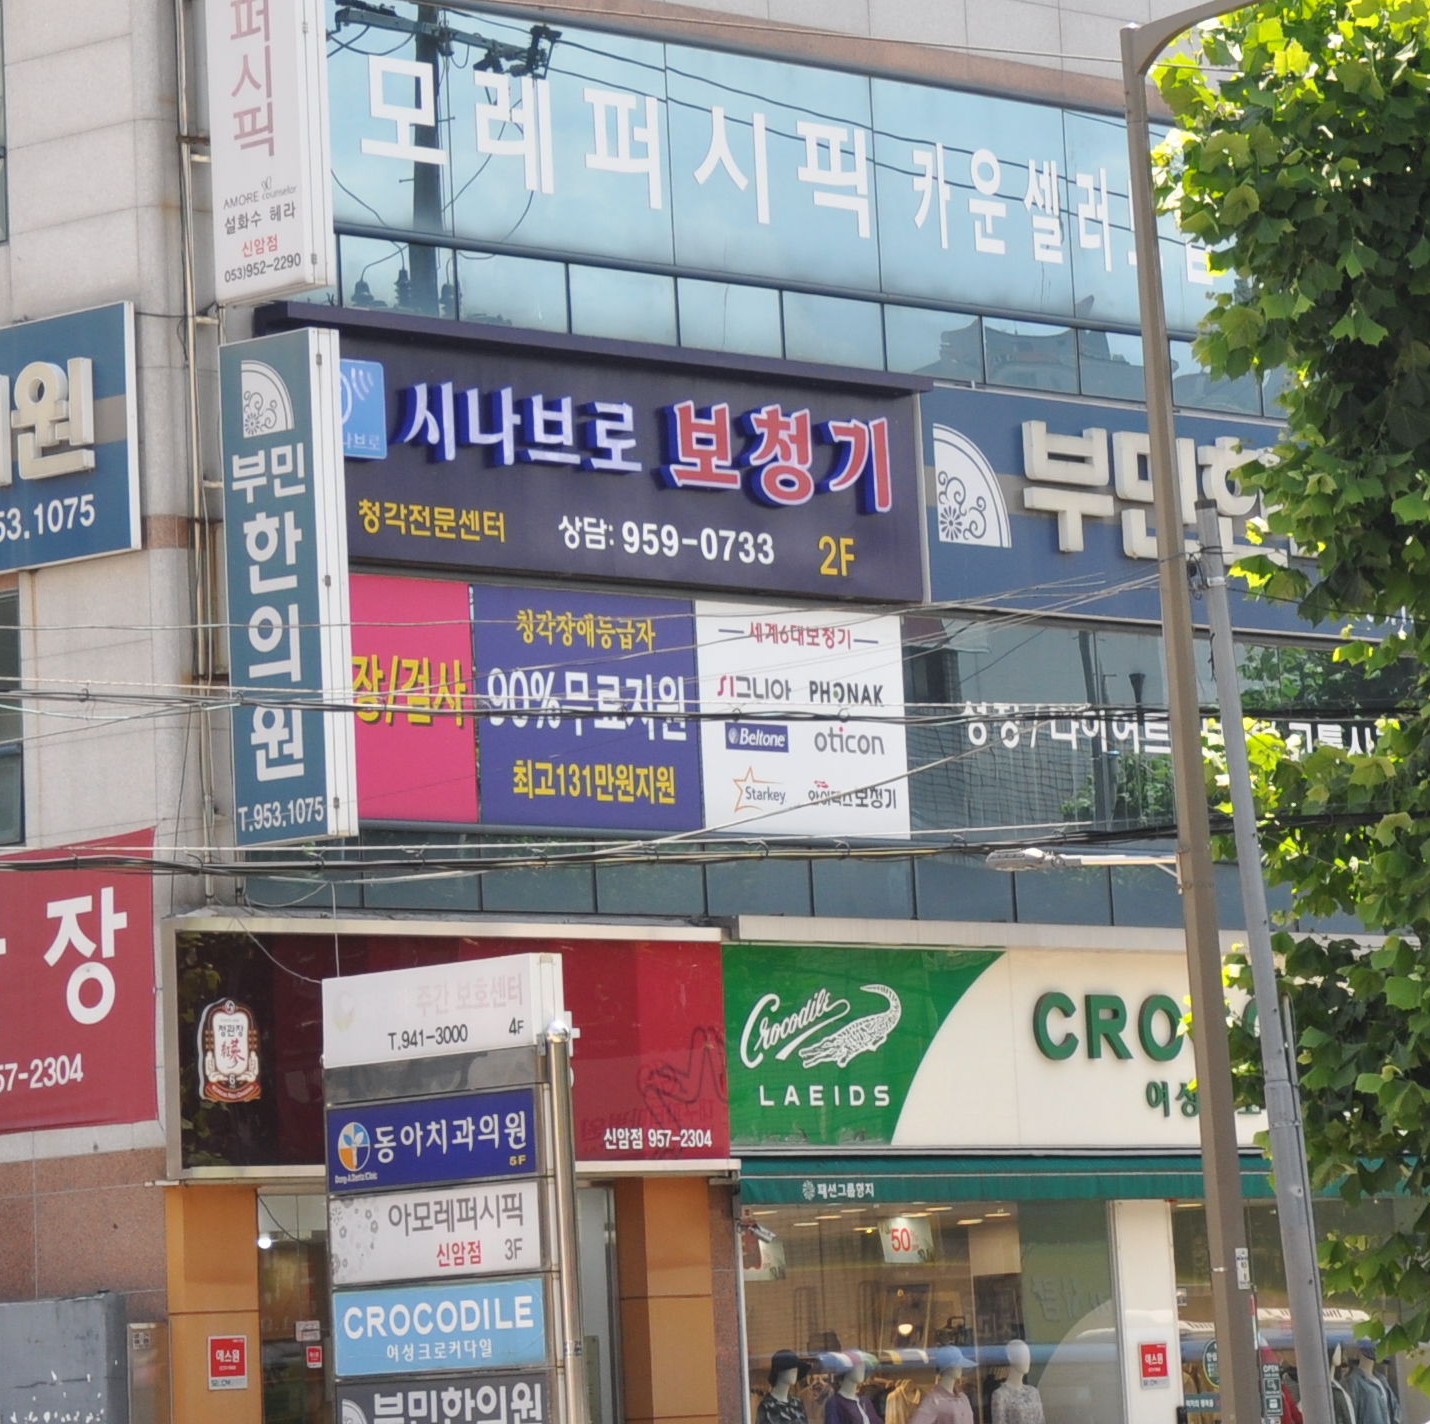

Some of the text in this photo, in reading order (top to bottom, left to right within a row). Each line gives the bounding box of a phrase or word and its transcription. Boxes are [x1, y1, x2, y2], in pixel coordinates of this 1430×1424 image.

[223, 190, 260, 210] AMORE
[224, 201, 296, 235] 설화수 헤라
[242, 234, 278, 258] 신암점
[224, 252, 302, 283] 053)952-2290
[404, 380, 893, 514] 시나브로 보청기
[359, 498, 505, 543] 청각전문센터
[817, 536, 855, 577] 2F
[231, 442, 307, 782] 부민한의원
[809, 680, 883, 704] PHONAK
[740, 727, 786, 748] Beltone
[814, 726, 885, 755] oticon
[745, 786, 786, 805] Starkey
[238, 796, 325, 833] T.953.1075
[388, 1023, 469, 1051] T.941-3000
[509, 1017, 524, 1036] 4F
[759, 1084, 890, 1107] LAEIDS
[374, 1111, 527, 1164] 동아치과의원
[603, 1127, 713, 1150] 신암점 957-2304
[509, 1155, 527, 1167] 5F
[388, 1192, 524, 1237] 아모레퍼시픽
[436, 1240, 482, 1267] 신암점
[505, 1238, 523, 1261] 3F
[891, 1228, 912, 1252] 50
[344, 1296, 534, 1340] CROCODILE
